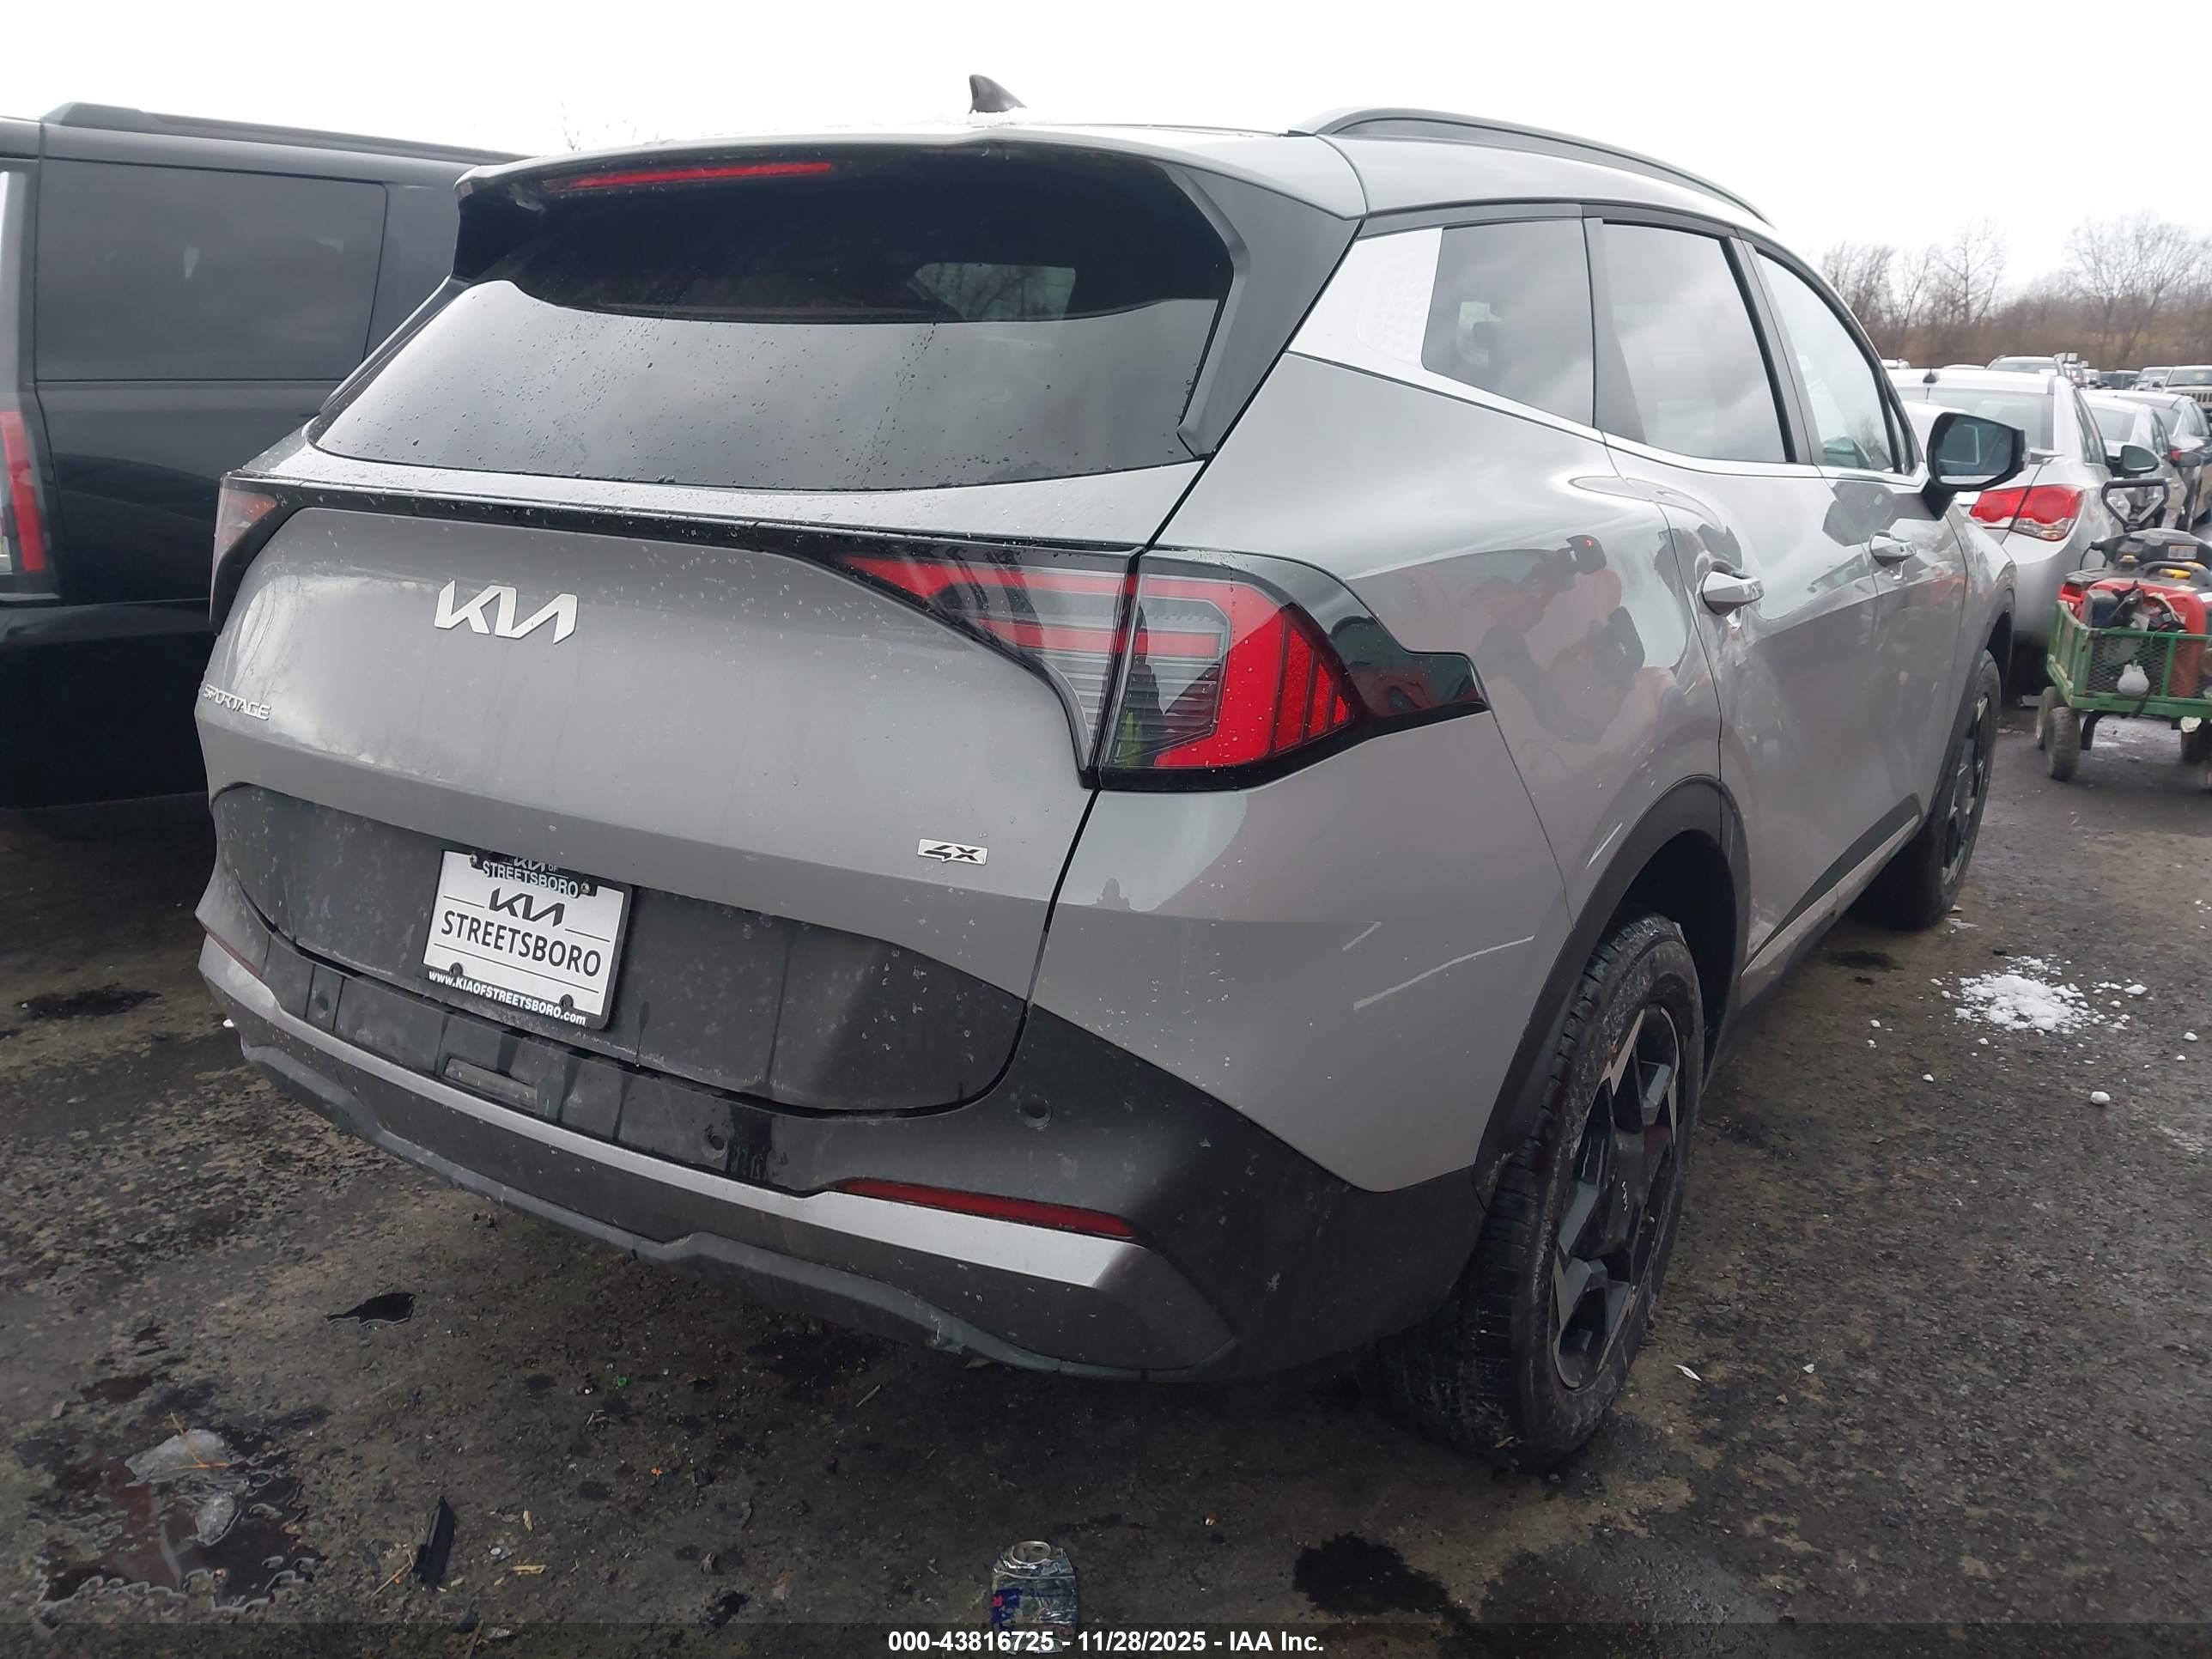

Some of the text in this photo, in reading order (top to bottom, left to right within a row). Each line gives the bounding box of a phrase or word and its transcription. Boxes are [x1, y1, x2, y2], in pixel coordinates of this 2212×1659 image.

[434, 580, 578, 644] KIA
[203, 684, 271, 721] SPORTAGE
[483, 860, 579, 899] STREETSBORO
[489, 886, 566, 927] KIA
[441, 910, 601, 977] STREETSBORO
[428, 970, 586, 1026] www.KIAOFSTREETSBORO.com
